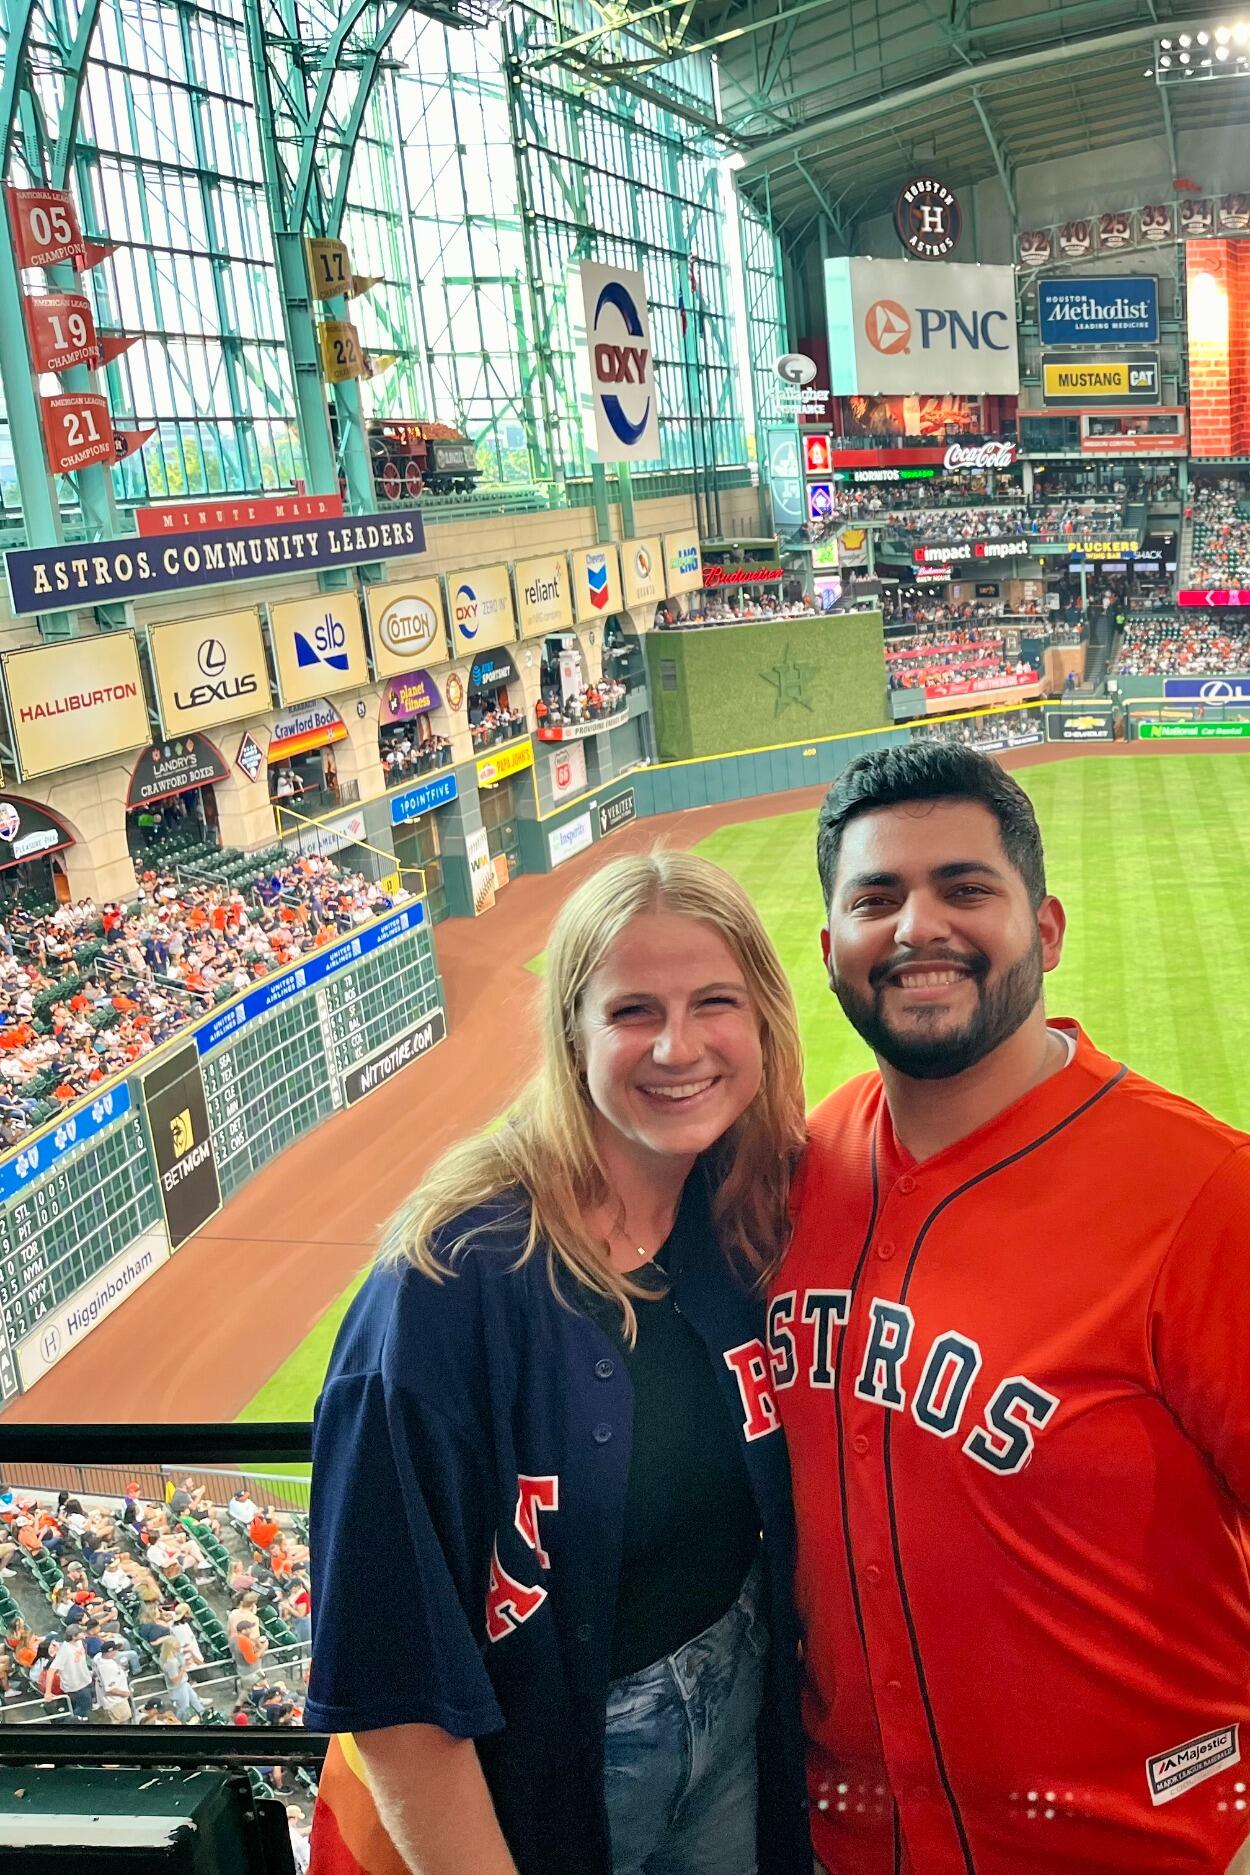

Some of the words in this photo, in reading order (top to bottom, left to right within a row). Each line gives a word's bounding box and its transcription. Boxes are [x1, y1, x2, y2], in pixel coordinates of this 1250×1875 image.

[17, 192, 52, 201] NATIONAL
[904, 181, 954, 205] HOUSTON
[920, 205, 944, 232] H
[1143, 205, 1169, 227] 33
[1183, 200, 1210, 220] 34
[30, 207, 72, 245] 05
[1061, 222, 1088, 242] 40
[1101, 213, 1127, 234] 25
[1021, 231, 1046, 252] 32
[31, 243, 87, 266] CHAMPIONS
[320, 253, 346, 282] 17
[34, 299, 68, 307] AMERICAN
[1048, 299, 1149, 321] Methodist
[48, 313, 87, 350] 19
[915, 308, 1010, 351] PNC
[48, 345, 100, 369] CHAMPIONS
[333, 340, 357, 365] 22
[594, 343, 649, 385] OXY
[1058, 373, 1121, 387] MUSTANG
[1130, 371, 1153, 386] CAT
[50, 398, 84, 408] AMERICAN
[63, 410, 100, 447] 21
[60, 443, 110, 468] CHAMPIONS
[854, 470, 900, 483] HORNITOS
[162, 508, 256, 528] MINUTE
[164, 533, 319, 576] COMMUNITY
[328, 521, 415, 553] LEADERS
[924, 543, 971, 562] impact
[983, 540, 1028, 557] impact
[1068, 541, 1139, 552] PLUCKERS
[525, 576, 560, 606] reliant
[456, 604, 478, 621] OXY
[314, 613, 346, 652] slb
[386, 613, 431, 645] COTTON
[20, 682, 138, 723] HALLIBURTON
[174, 674, 258, 710] LEXUS
[400, 682, 424, 704] planet
[404, 694, 431, 713] fitness
[275, 715, 313, 739] Crawford
[315, 709, 336, 727] Bock
[1162, 726, 1198, 737] National
[1201, 727, 1215, 735] Car
[153, 753, 197, 776] LANDRY'S
[557, 765, 571, 786] 66
[141, 775, 187, 798] CRAWFORD
[190, 765, 214, 782] BOXES
[400, 783, 450, 815] 1POINTFIVE
[607, 796, 633, 818] VERITEX
[471, 855, 488, 872] WM
[377, 925, 401, 943] AIRLINES
[380, 919, 400, 934] UNITED
[325, 951, 353, 971] AIRLINES
[329, 944, 351, 961] UNITED
[270, 975, 295, 994] UNITED
[344, 975, 353, 987] TB
[266, 984, 296, 1006] AIRLINES
[209, 1020, 237, 1043] AIRLINES
[213, 1011, 235, 1032] UNITED
[219, 1053, 231, 1070] SEA
[360, 1023, 433, 1093] NITTOTIRE.COM
[221, 1067, 234, 1083] TEX
[224, 1085, 236, 1101] CLE
[162, 1140, 211, 1192] BETMGM
[14, 1205, 31, 1225] STL
[18, 1221, 32, 1242] PIT
[20, 1241, 38, 1263] TOR
[23, 1260, 43, 1284] NYM
[28, 1281, 47, 1306] NYY
[34, 1303, 47, 1321] LA
[44, 1331, 57, 1359] H
[66, 1251, 153, 1336] Higginbotham
[767, 1289, 1060, 1476] STROS
[1178, 1736, 1227, 1765] Majestic
[1156, 1775, 1178, 1792] MAJOR
